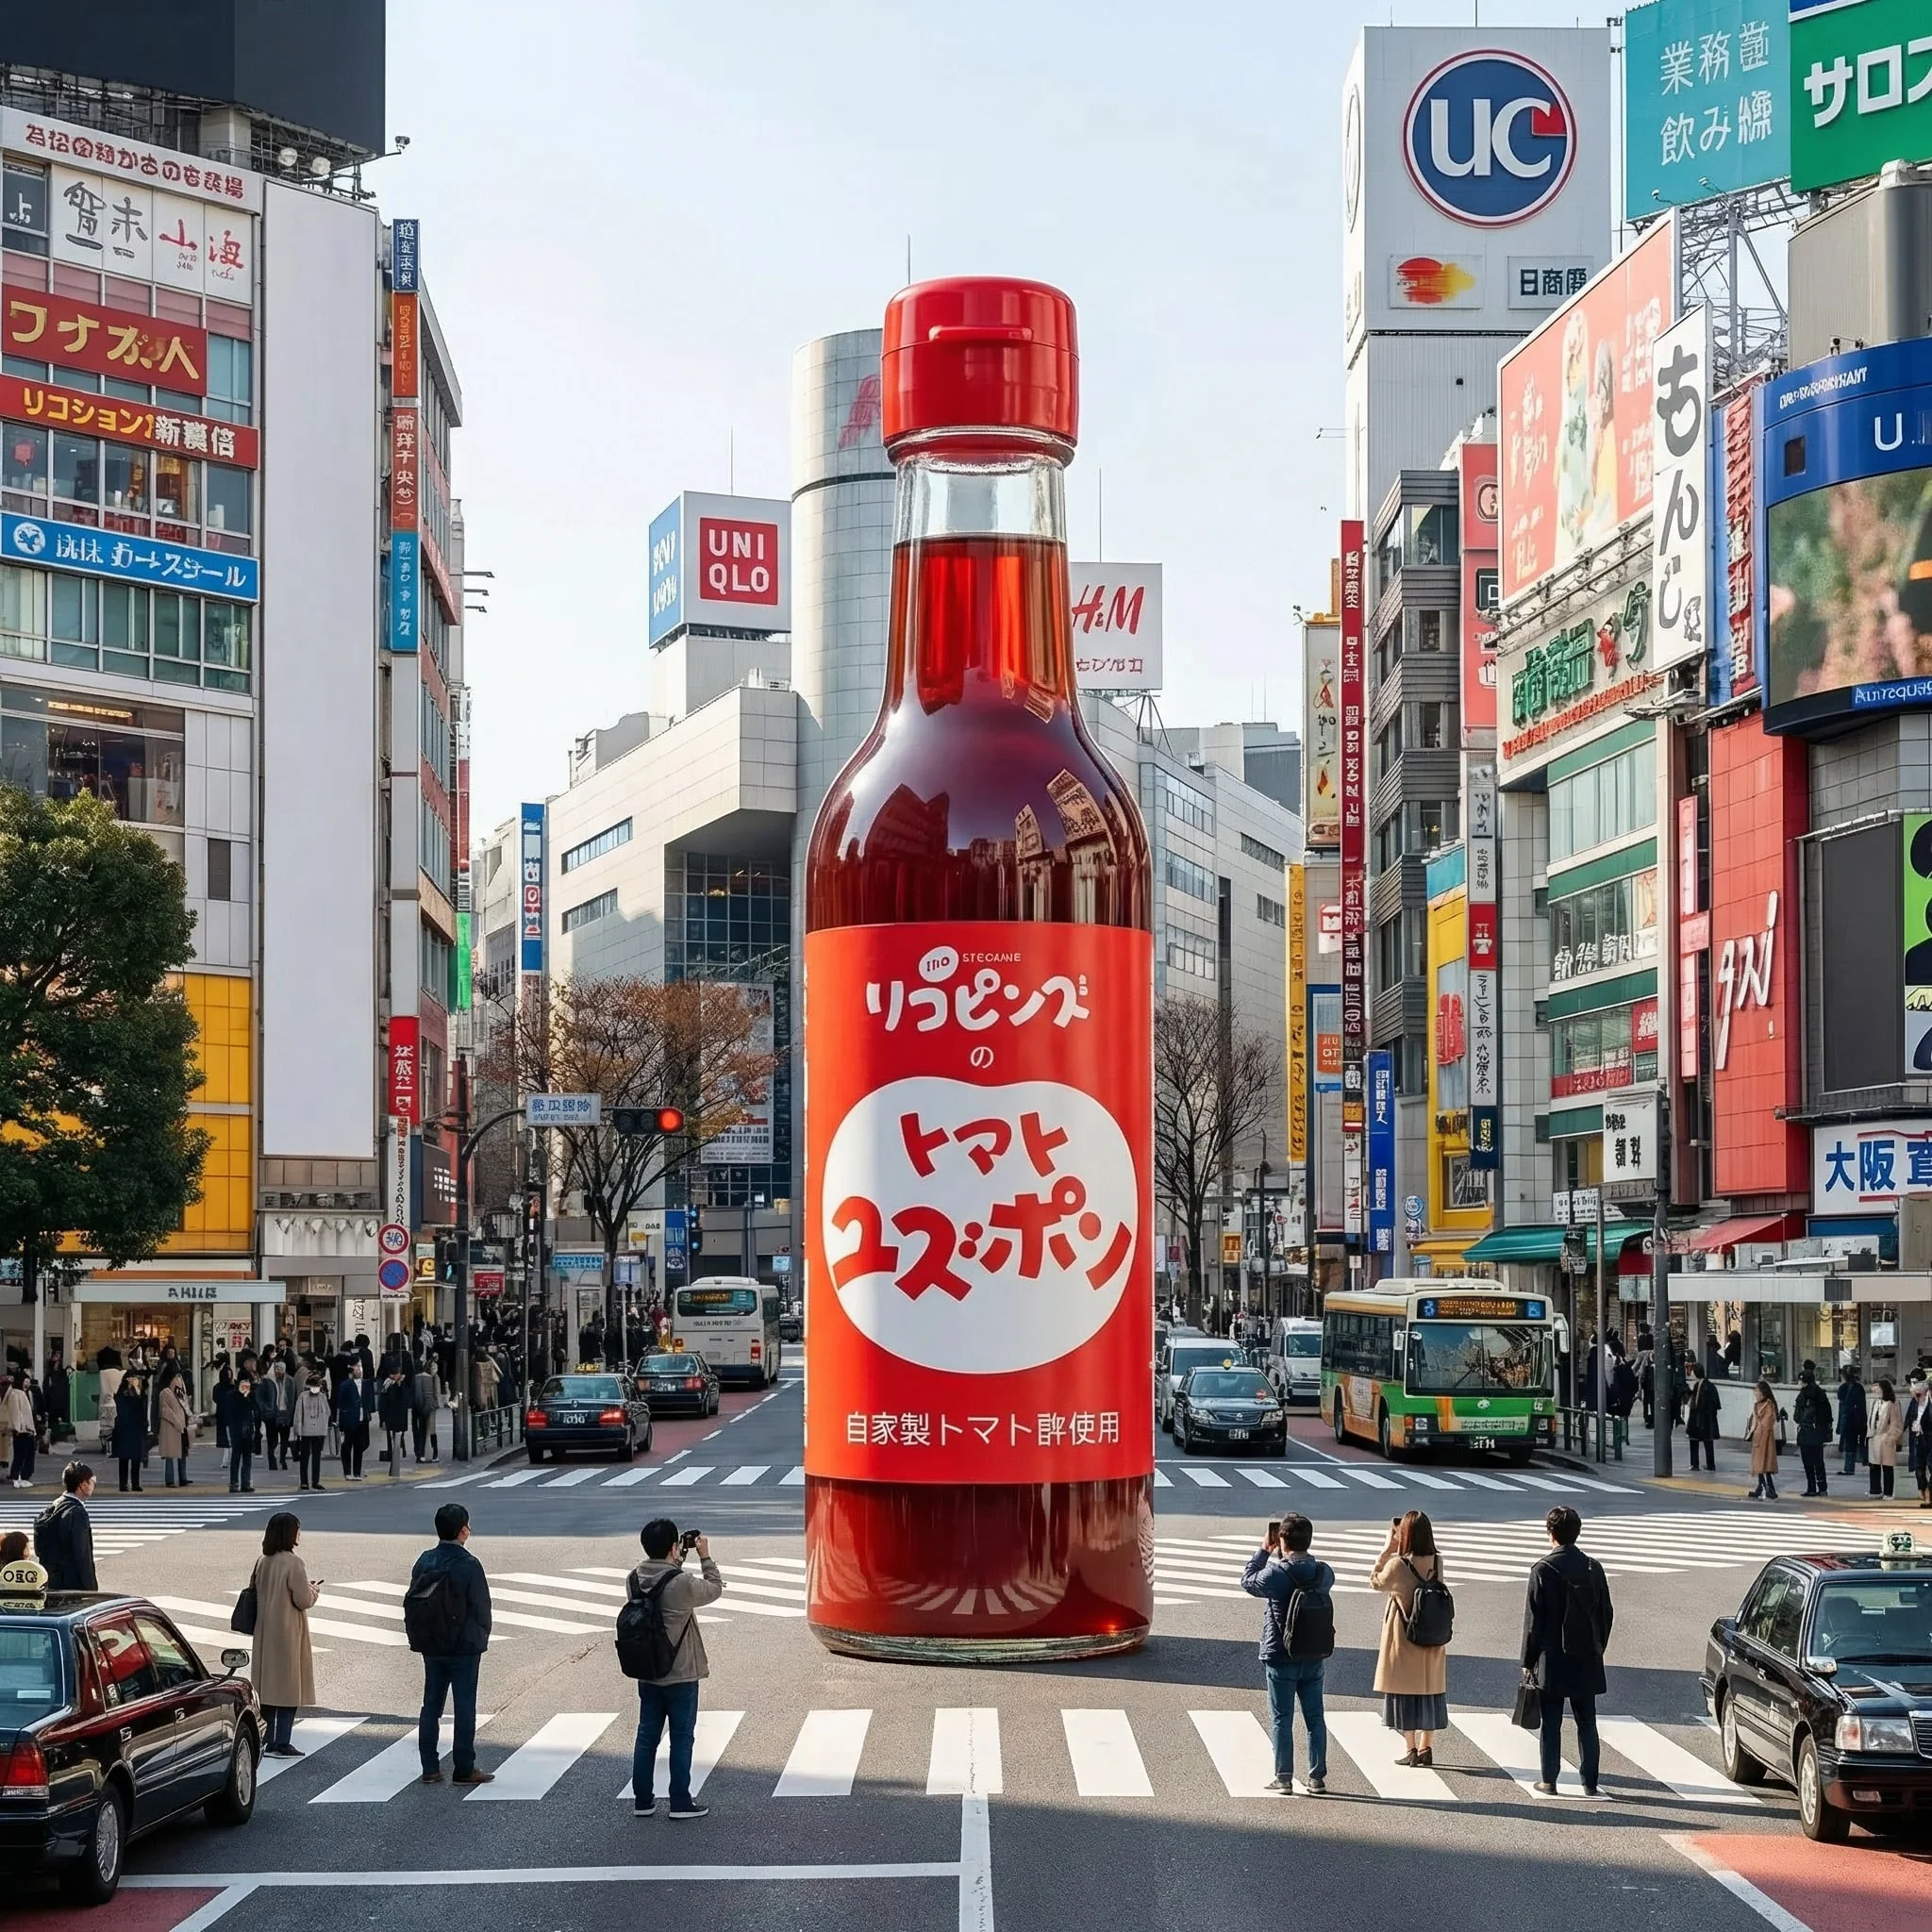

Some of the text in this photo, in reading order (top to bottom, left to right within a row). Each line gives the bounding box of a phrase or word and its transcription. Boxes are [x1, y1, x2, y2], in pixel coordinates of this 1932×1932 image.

[1430, 97, 1551, 178] UC
[708, 528, 765, 560] UNI
[708, 562, 770, 595] QLO
[1072, 584, 1145, 635] H&M
[866, 969, 1091, 1032] リコピンズ
[970, 1046, 994, 1069] の
[899, 1110, 1069, 1178] トマト
